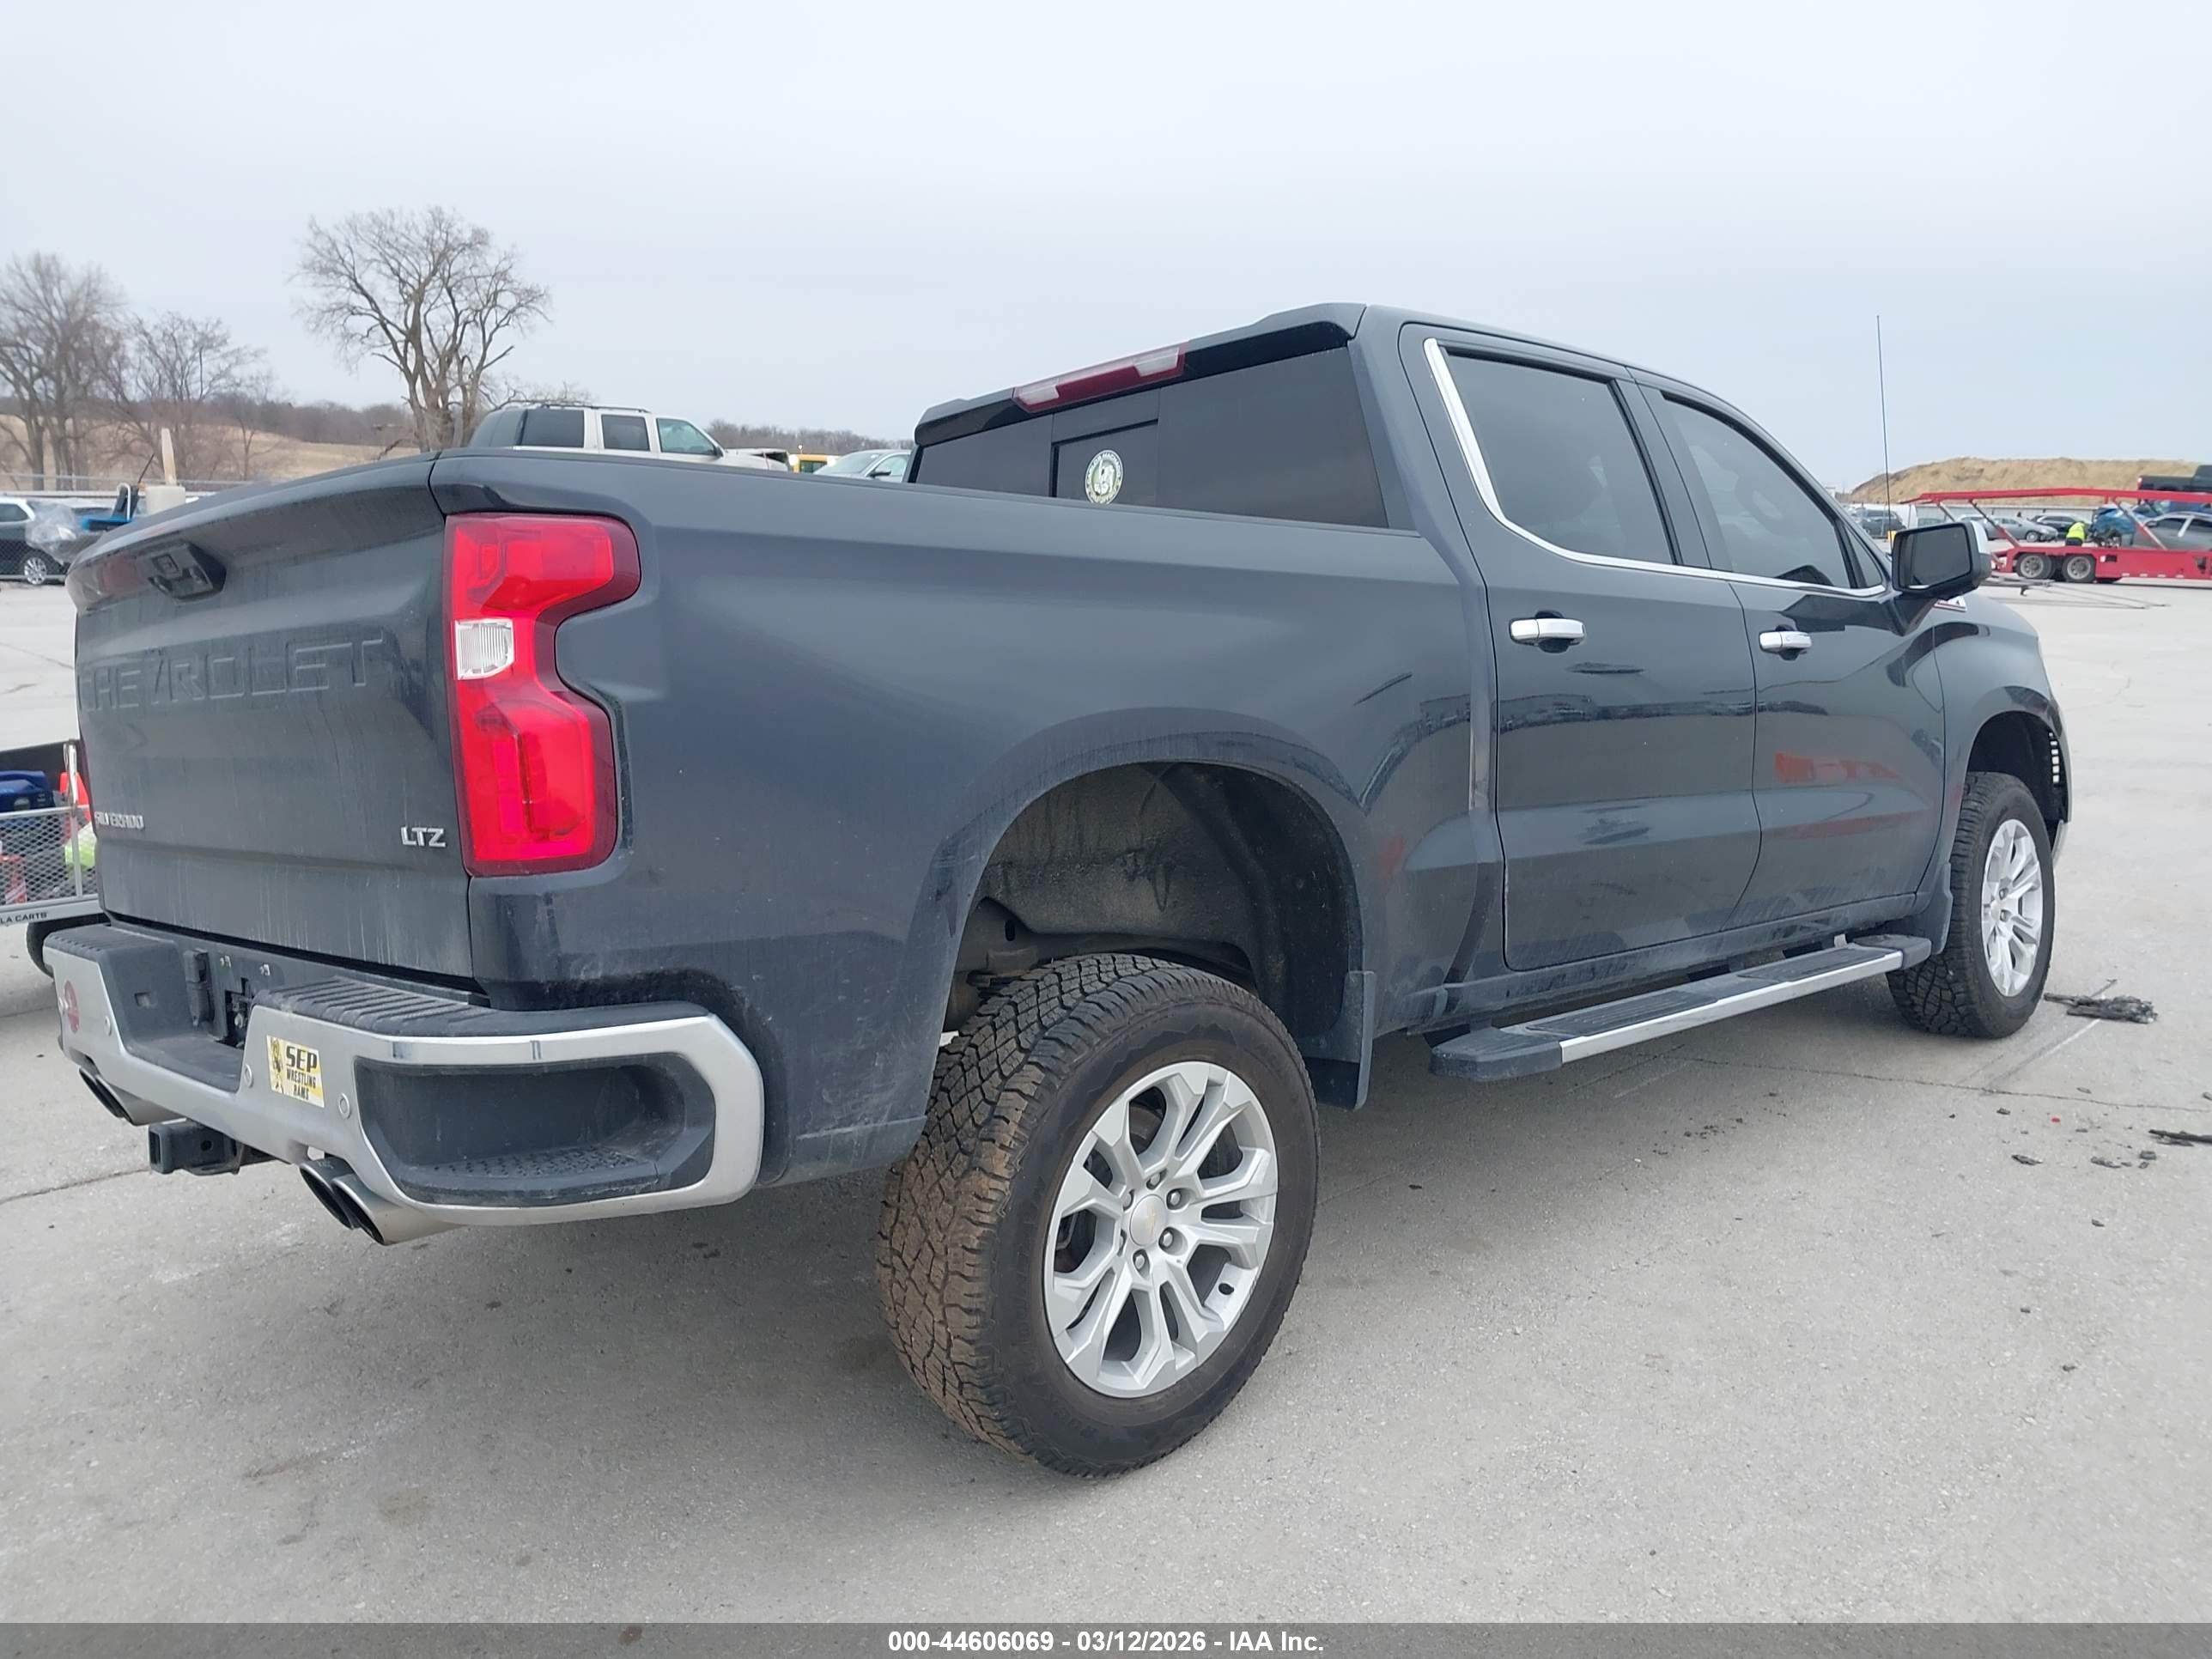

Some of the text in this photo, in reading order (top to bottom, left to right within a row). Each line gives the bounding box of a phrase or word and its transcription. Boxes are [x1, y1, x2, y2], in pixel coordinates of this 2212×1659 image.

[77, 630, 384, 713] CHEVROLET
[400, 826, 447, 848] LTZ
[286, 1045, 318, 1073] SEP
[286, 1067, 316, 1089] WRESTLING
[293, 1083, 309, 1101] RAMS
